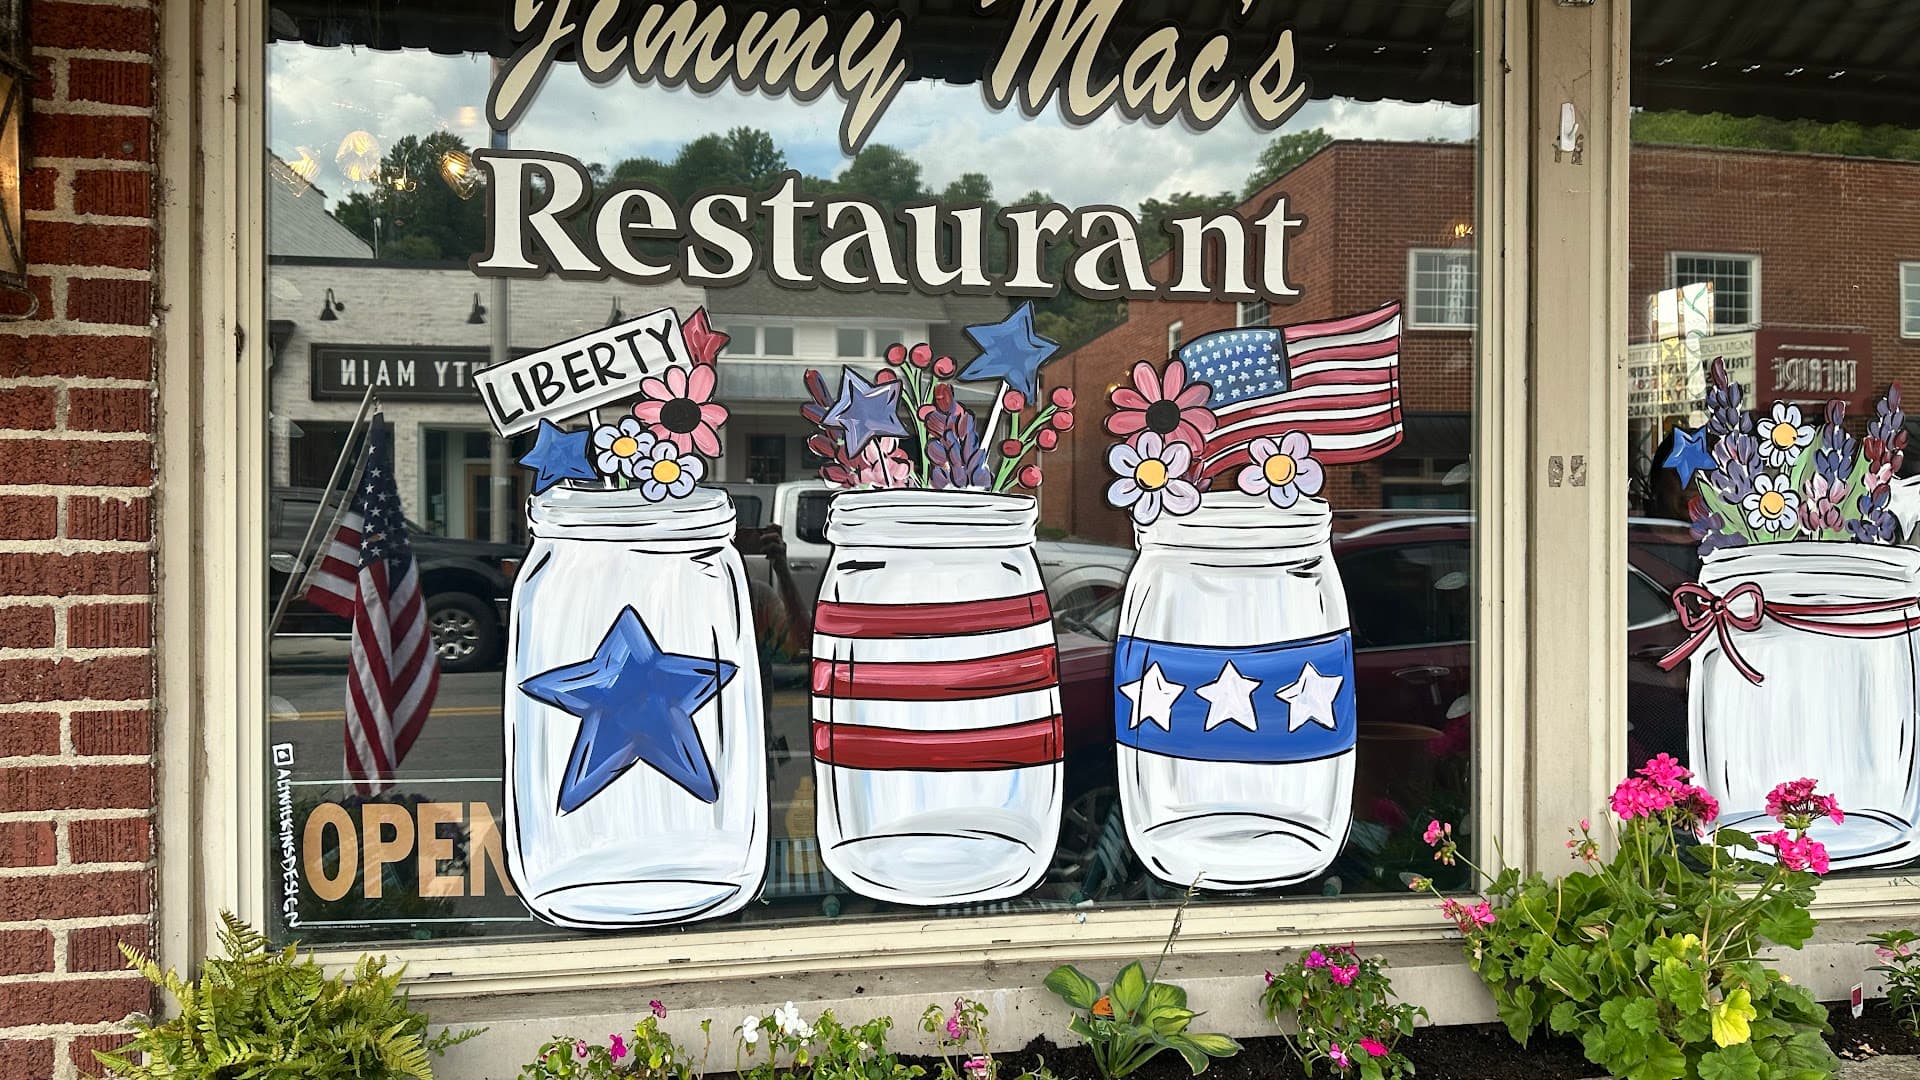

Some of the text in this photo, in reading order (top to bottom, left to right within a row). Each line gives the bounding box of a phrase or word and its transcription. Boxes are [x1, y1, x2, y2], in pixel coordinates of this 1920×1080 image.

[477, 155, 1304, 294] Restaurant
[486, 317, 678, 425] LIBERTY
[302, 801, 519, 902] OPEN
